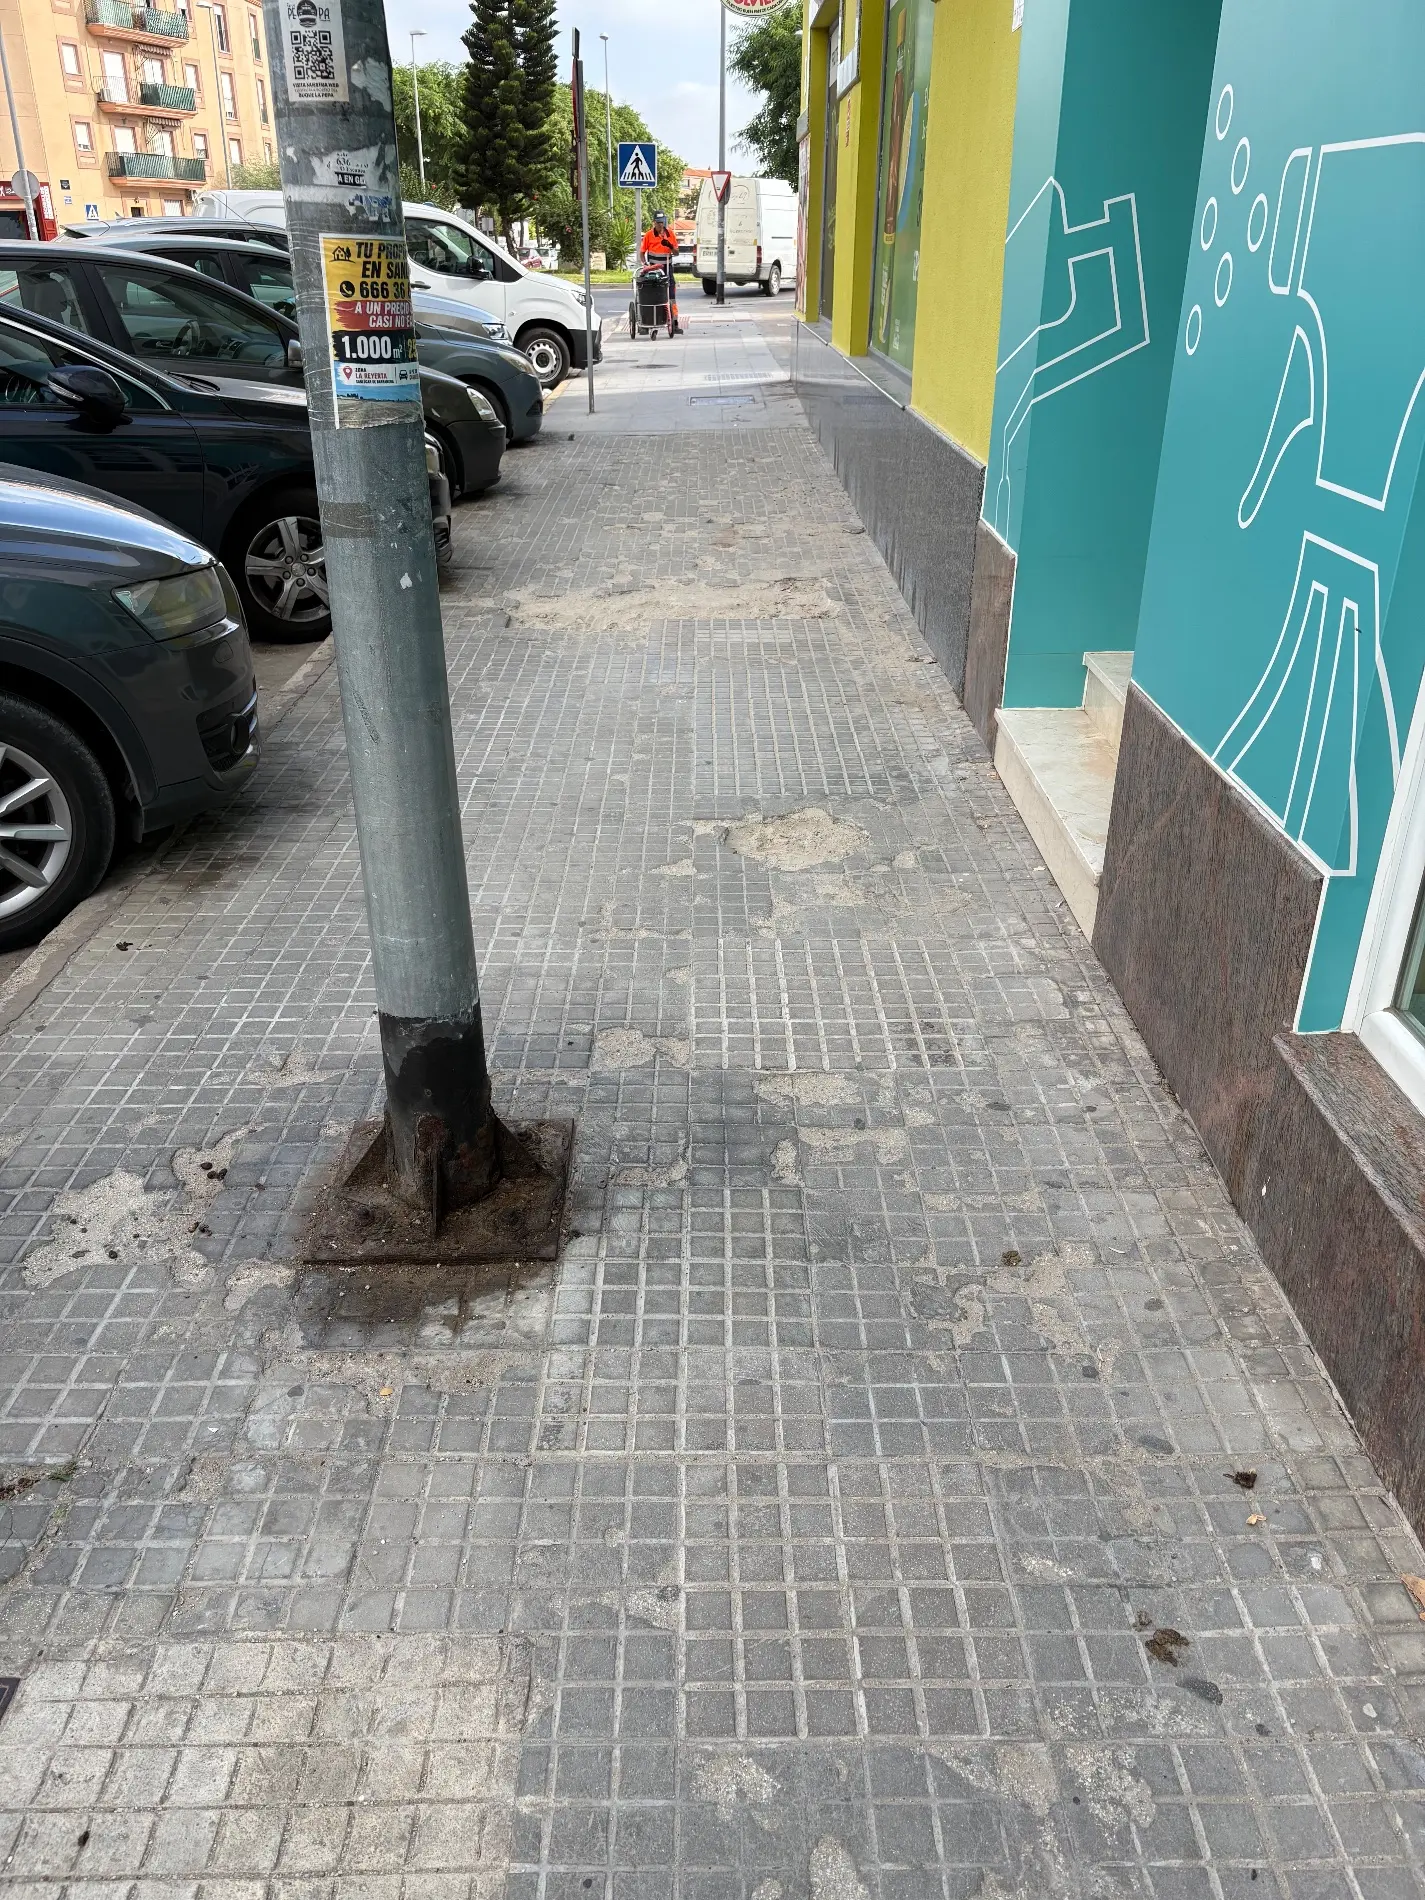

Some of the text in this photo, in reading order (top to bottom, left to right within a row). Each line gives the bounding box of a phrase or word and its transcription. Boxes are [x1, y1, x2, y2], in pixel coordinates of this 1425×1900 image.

[344, 174, 354, 184] EN
[355, 242, 374, 259] TU
[361, 260, 382, 279] EN
[360, 280, 390, 299] 666
[393, 281, 406, 299] 36
[354, 301, 363, 314] A
[366, 301, 381, 315] UN
[384, 301, 409, 315] PRECIO
[369, 315, 393, 328] CASI
[395, 315, 405, 328] NO
[341, 335, 392, 359] 1.000
